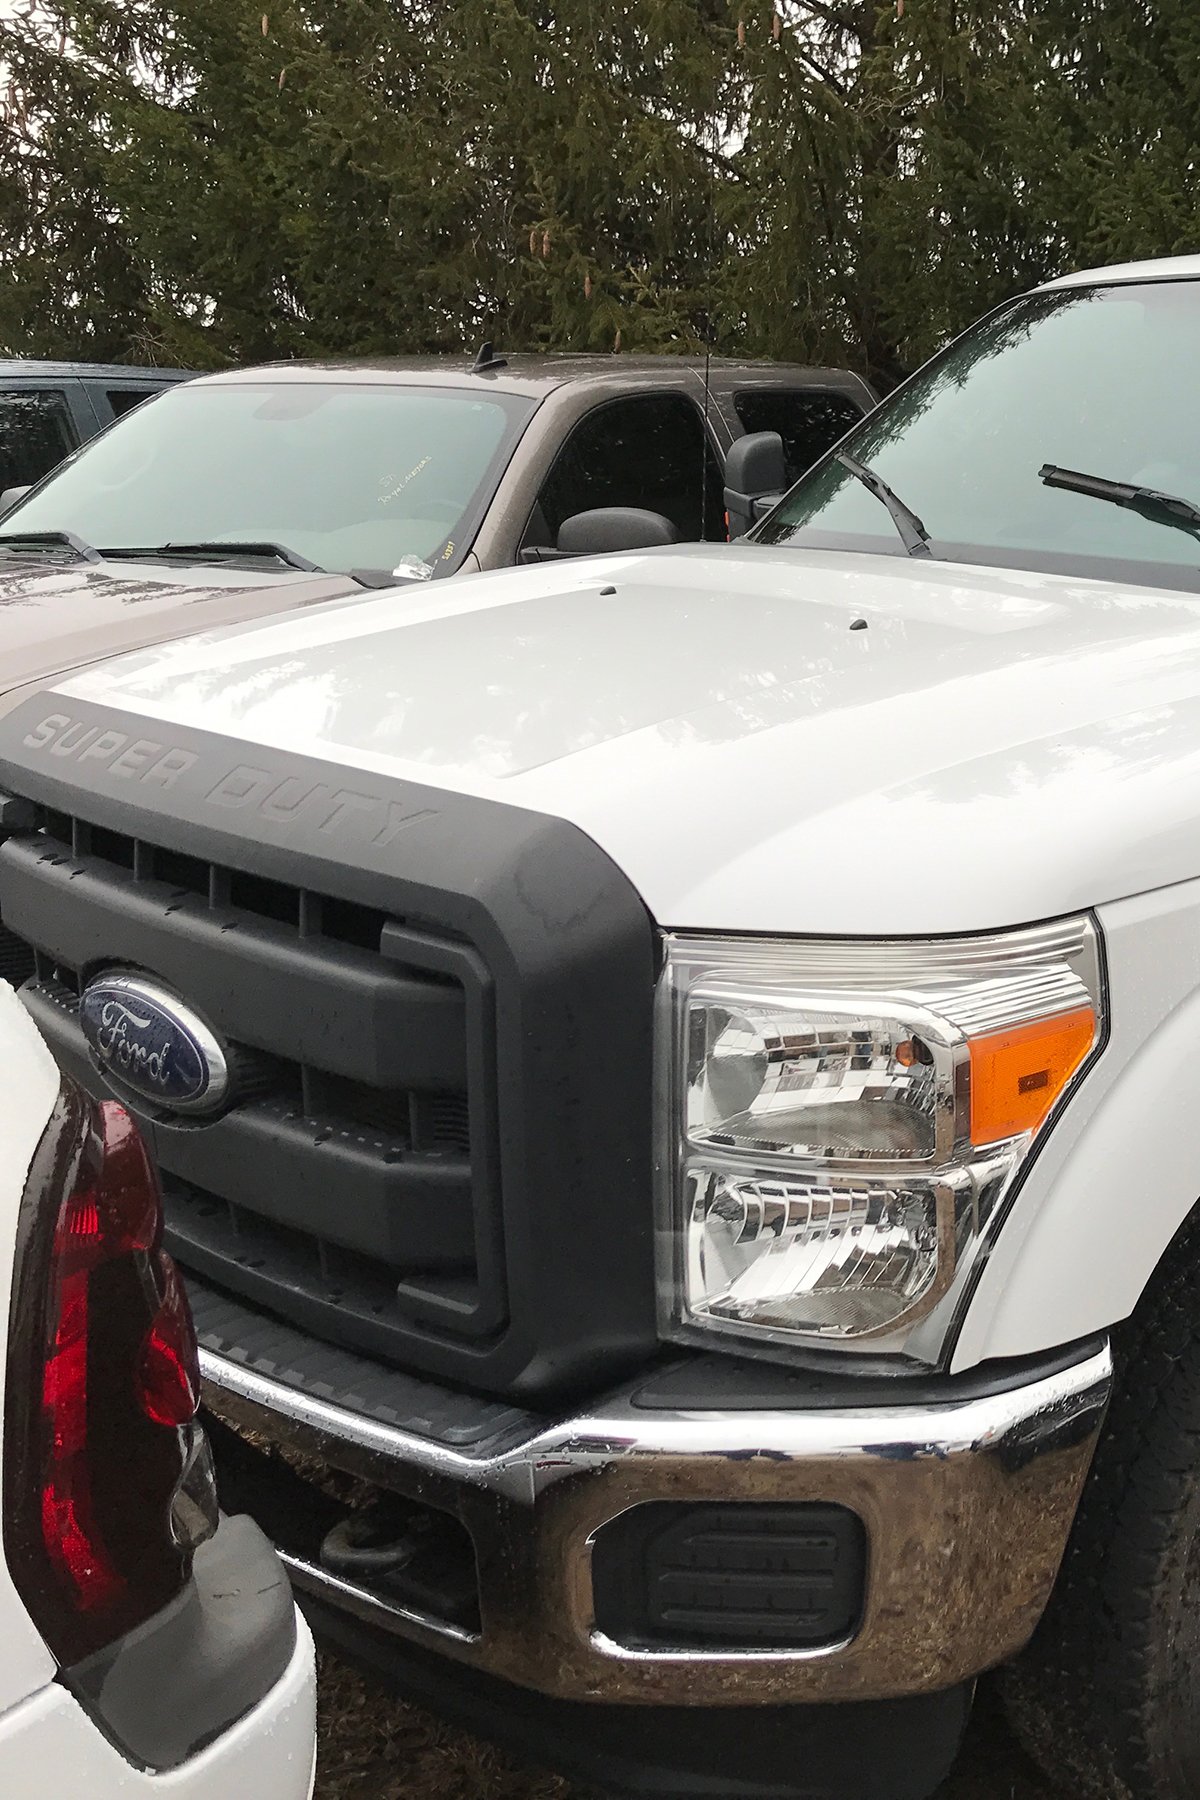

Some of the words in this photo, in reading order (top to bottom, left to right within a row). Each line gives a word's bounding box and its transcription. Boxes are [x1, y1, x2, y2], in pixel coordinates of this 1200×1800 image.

[23, 713, 199, 790] SUPER
[203, 763, 440, 847] DUTY
[99, 1000, 171, 1085] Ford
